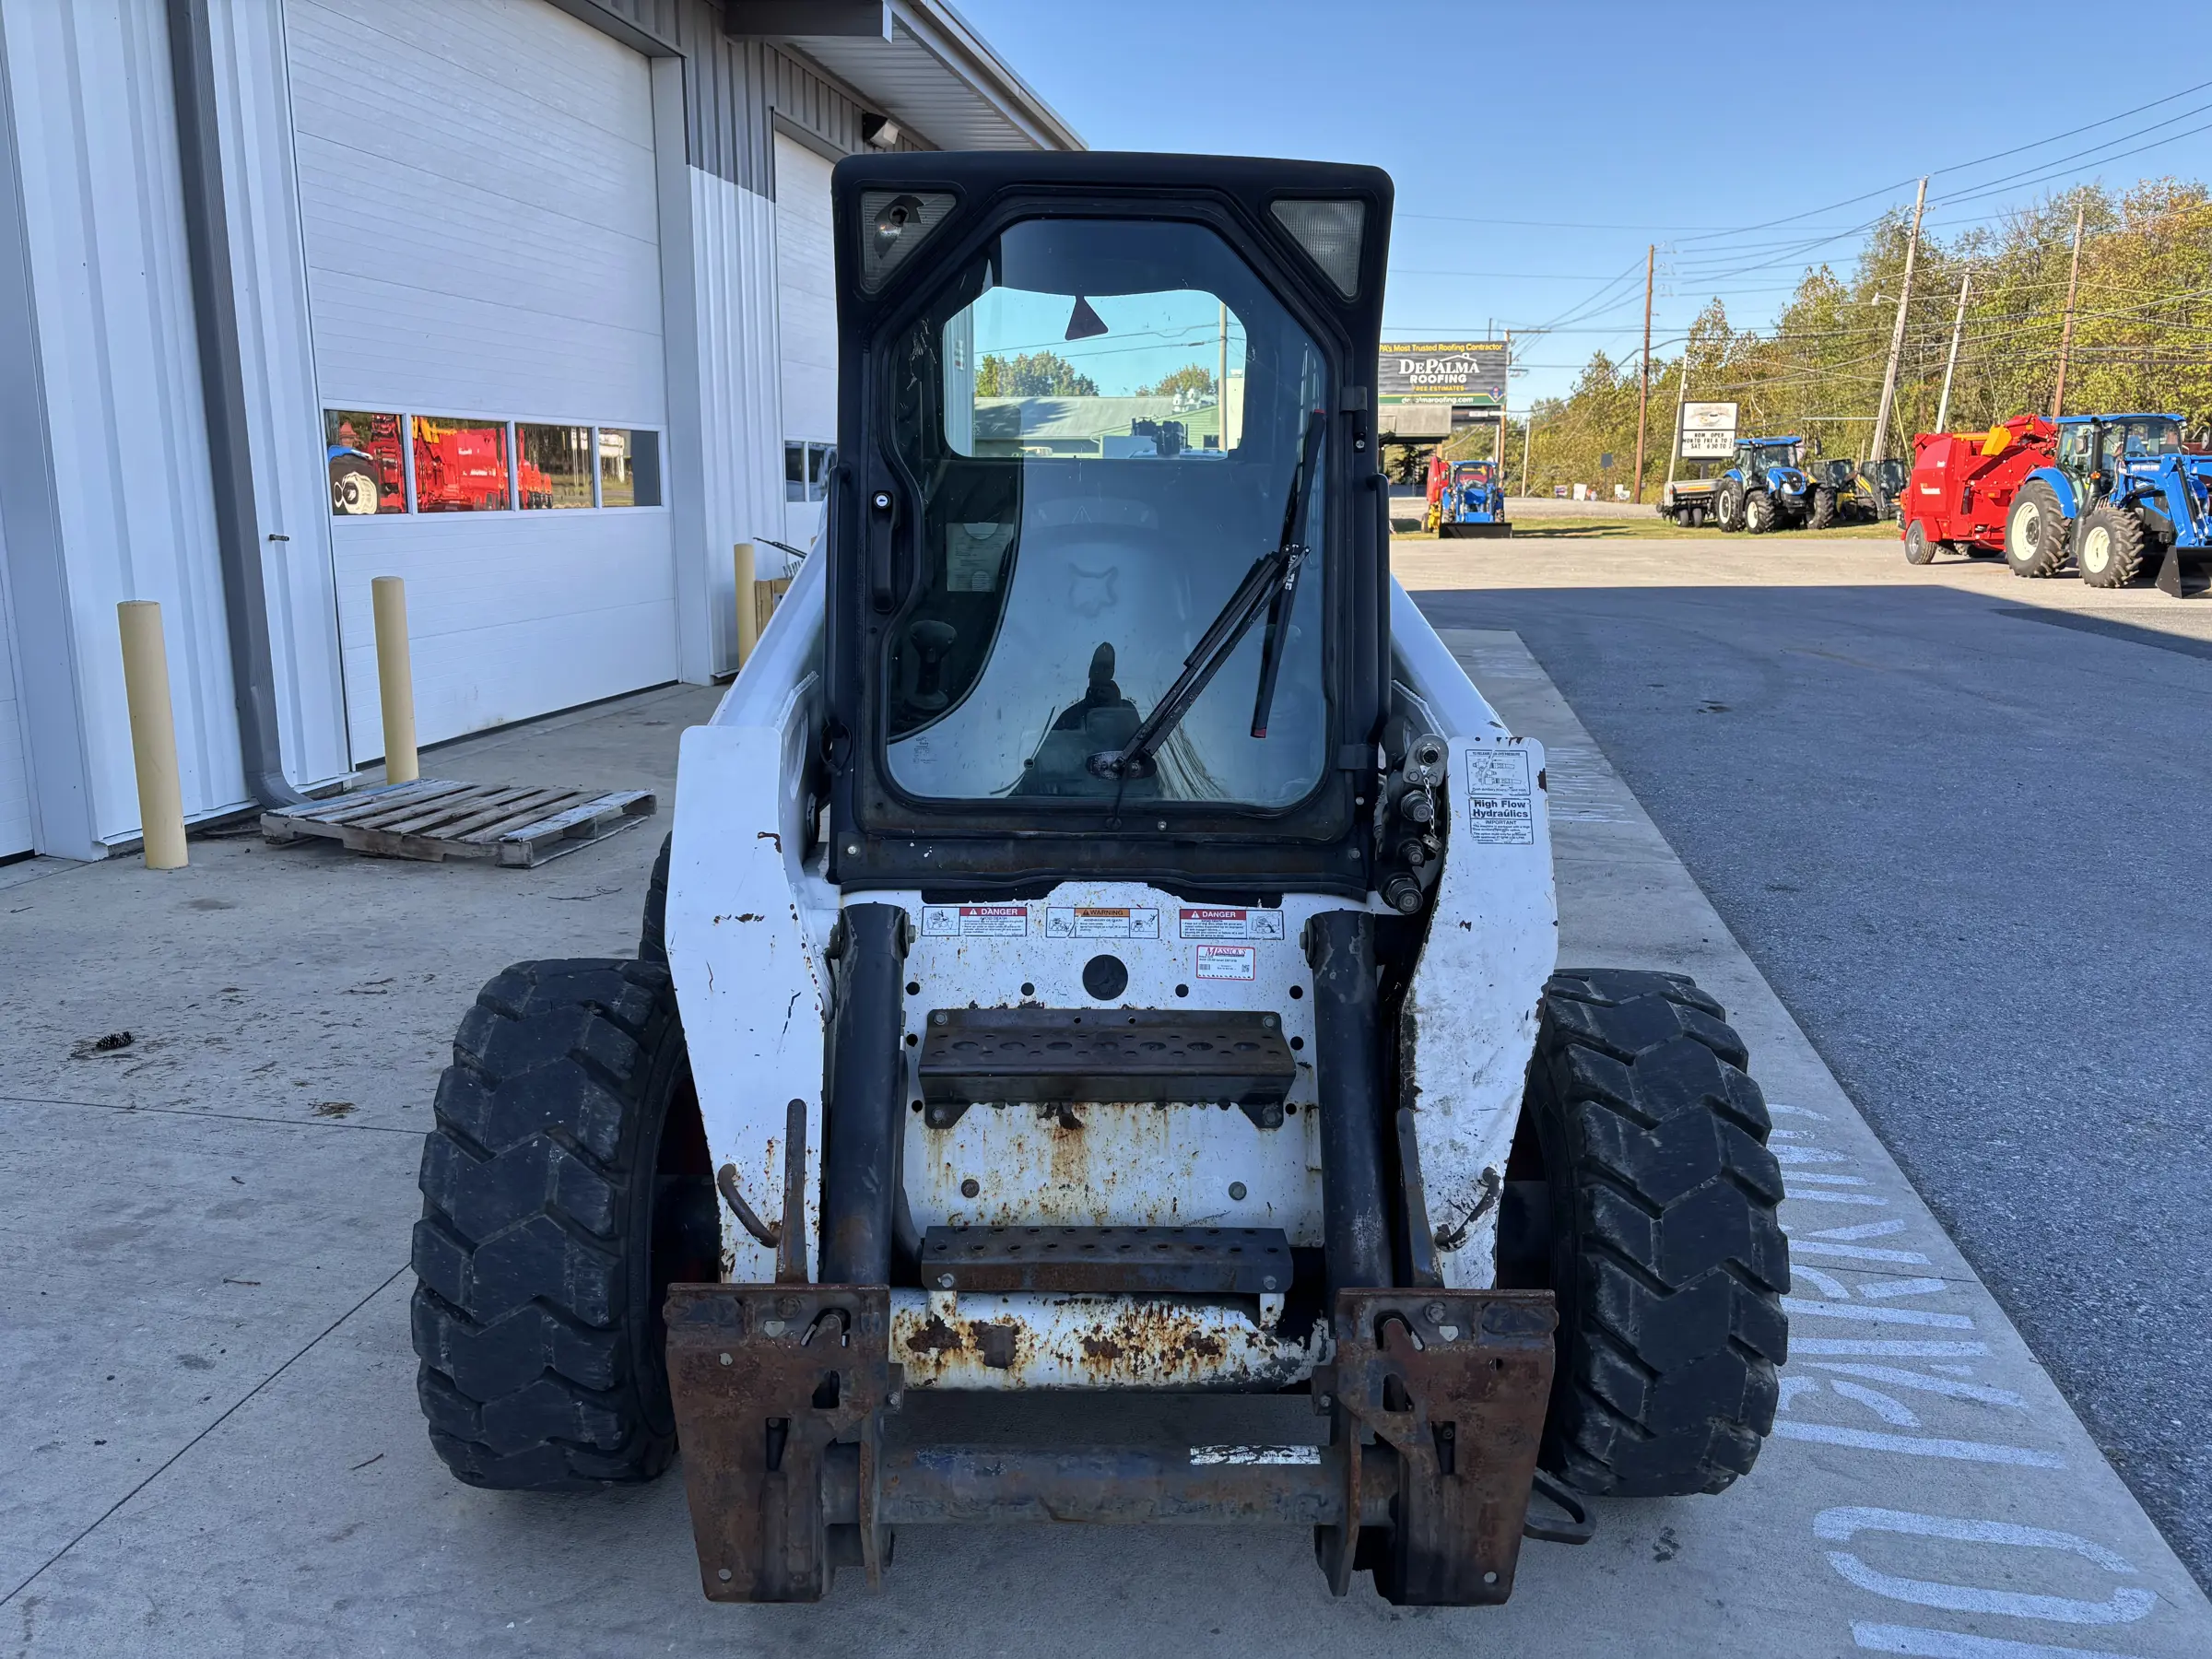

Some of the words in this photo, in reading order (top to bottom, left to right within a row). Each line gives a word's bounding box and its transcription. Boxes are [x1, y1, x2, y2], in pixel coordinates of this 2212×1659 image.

[1438, 344, 1465, 352] Roofing
[1466, 343, 1503, 351] Contractor
[1409, 374, 1467, 384] ROOFING
[1475, 800, 1498, 809] High
[1501, 800, 1525, 808] Flow
[1472, 809, 1529, 818] Hydraulics
